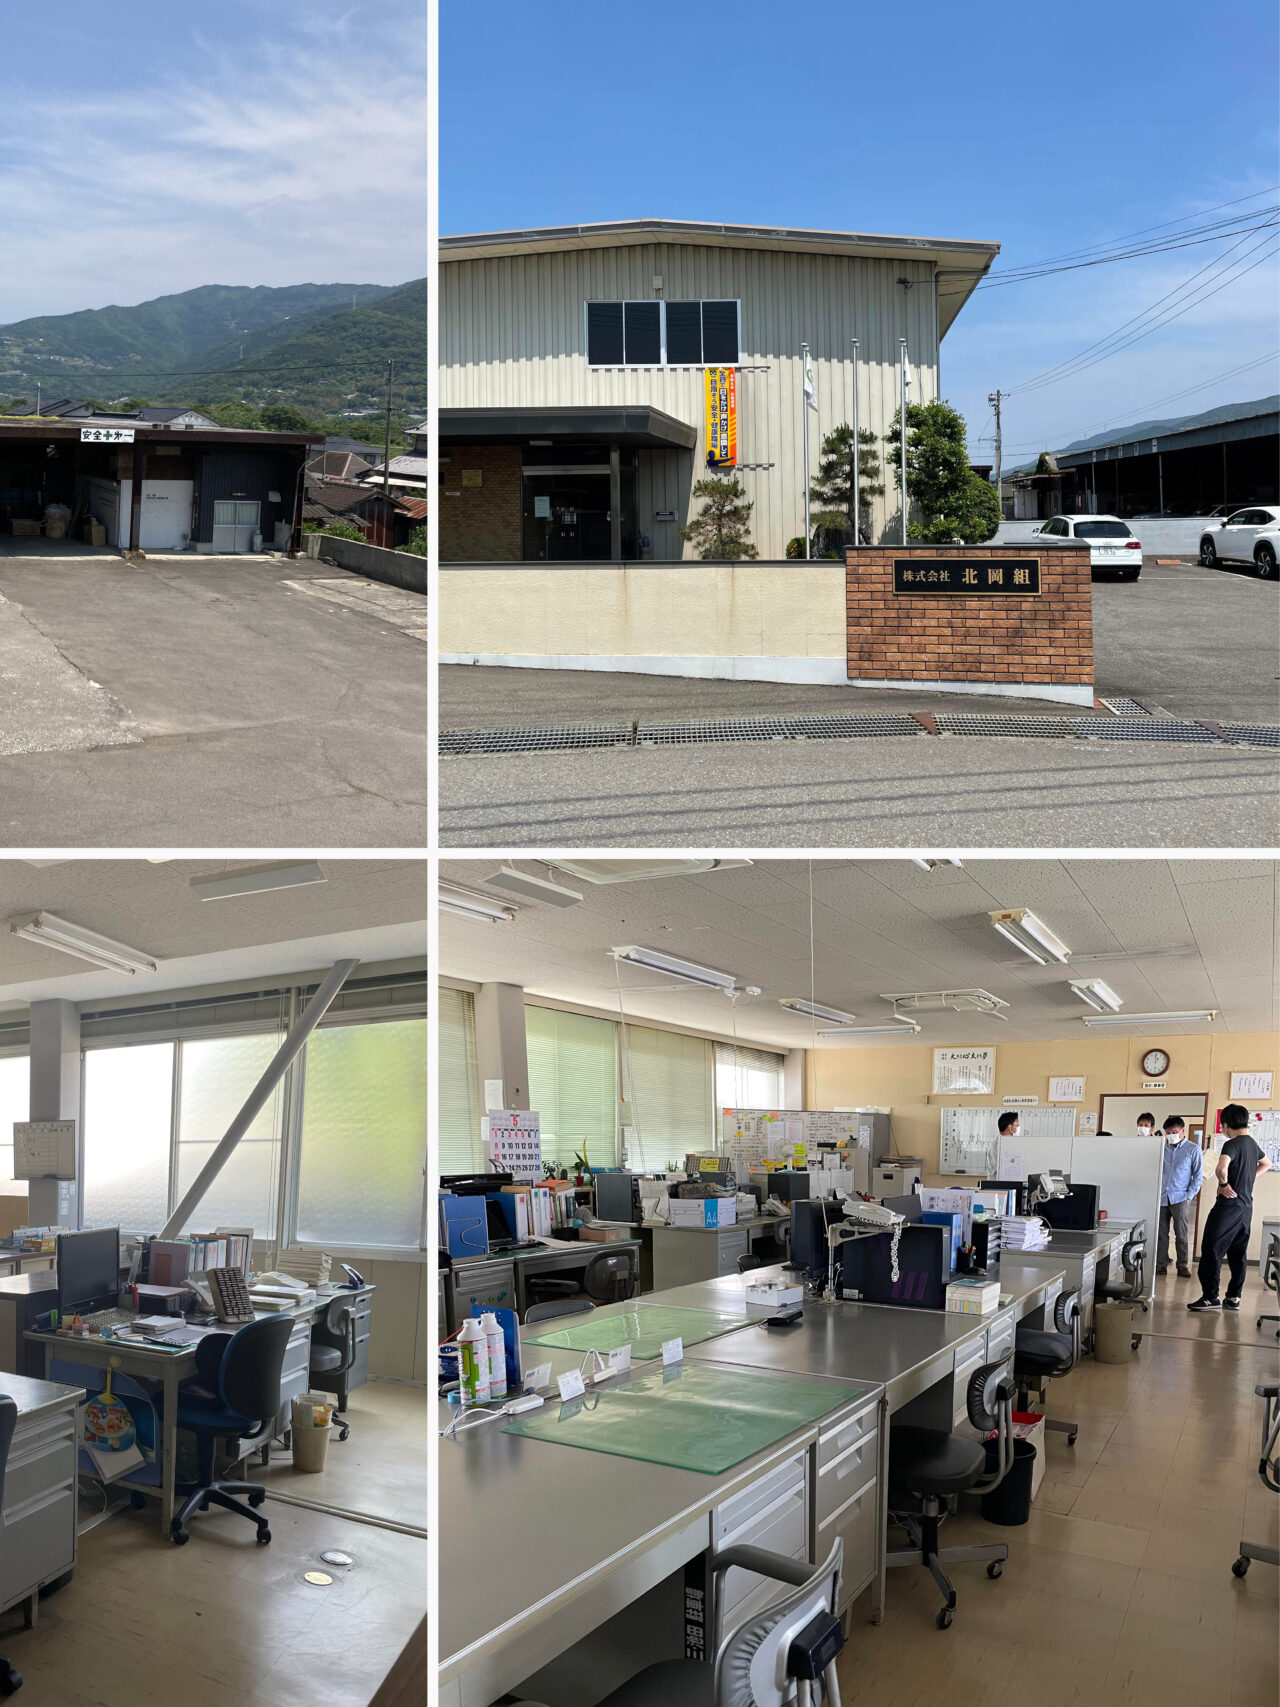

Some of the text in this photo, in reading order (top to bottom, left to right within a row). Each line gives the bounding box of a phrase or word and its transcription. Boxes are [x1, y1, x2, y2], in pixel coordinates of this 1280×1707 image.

[83, 430, 102, 440] 安全
[903, 568, 1030, 585] 株式会社 北岡組
[512, 1116, 518, 1127] 5
[707, 1212, 716, 1224] A4
[686, 1587, 704, 1661] 三池田 駐車場
